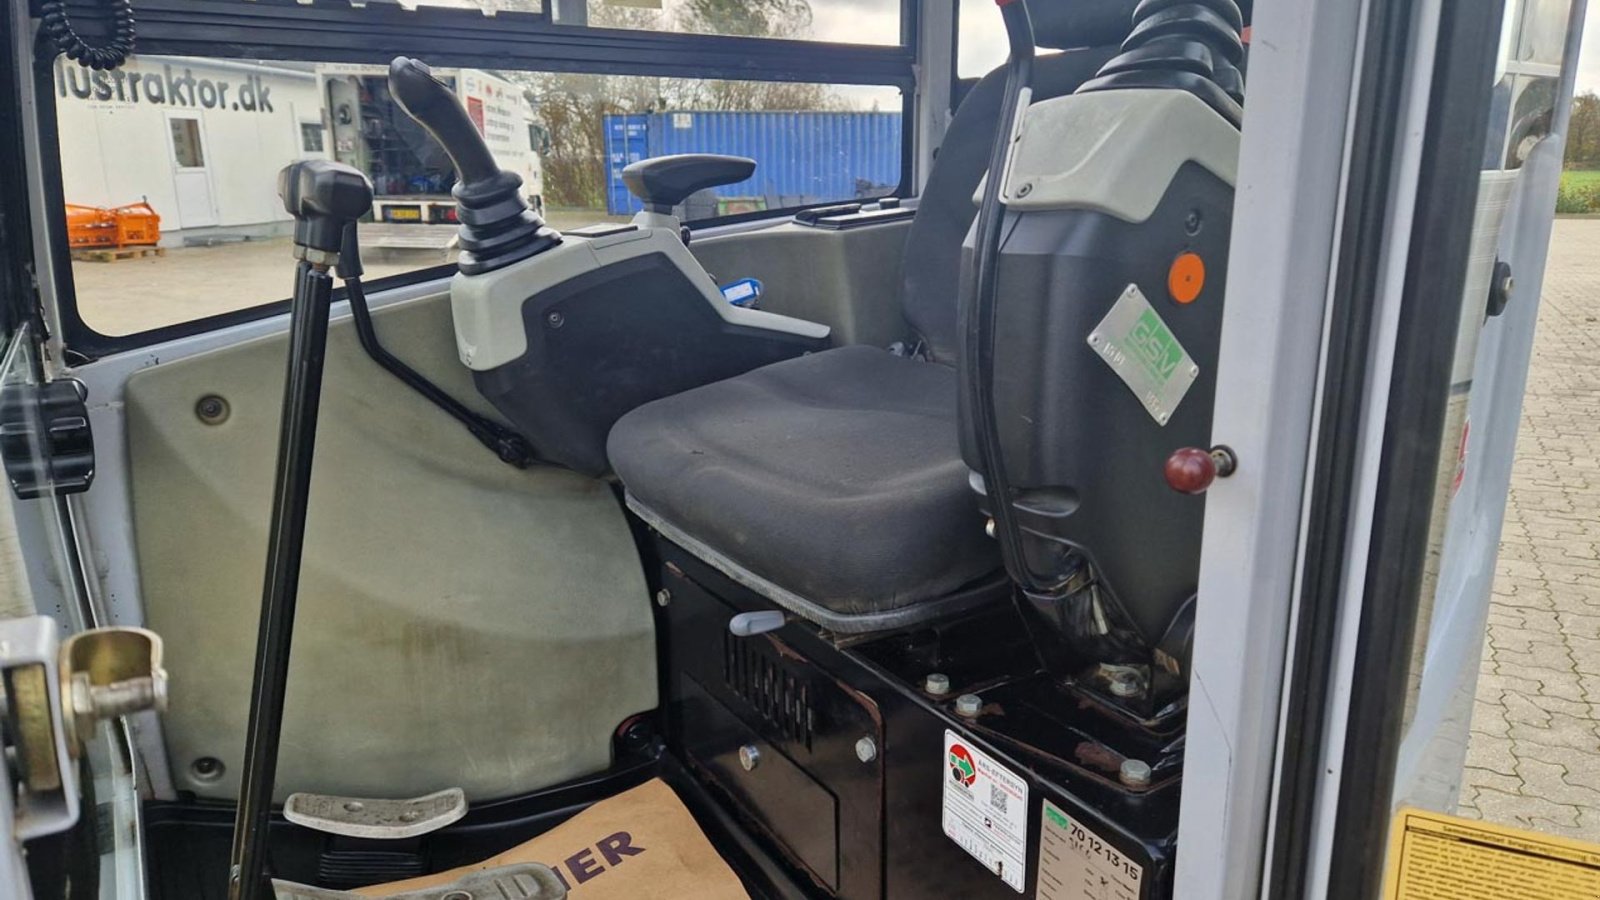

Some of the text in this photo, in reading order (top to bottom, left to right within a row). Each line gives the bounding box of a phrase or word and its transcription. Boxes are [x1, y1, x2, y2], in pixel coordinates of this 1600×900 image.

[1131, 321, 1176, 375] GSV
[1070, 823, 1085, 842] 70
[1088, 837, 1102, 855] 12
[1105, 849, 1120, 867] 13
[1123, 862, 1138, 880] 15
